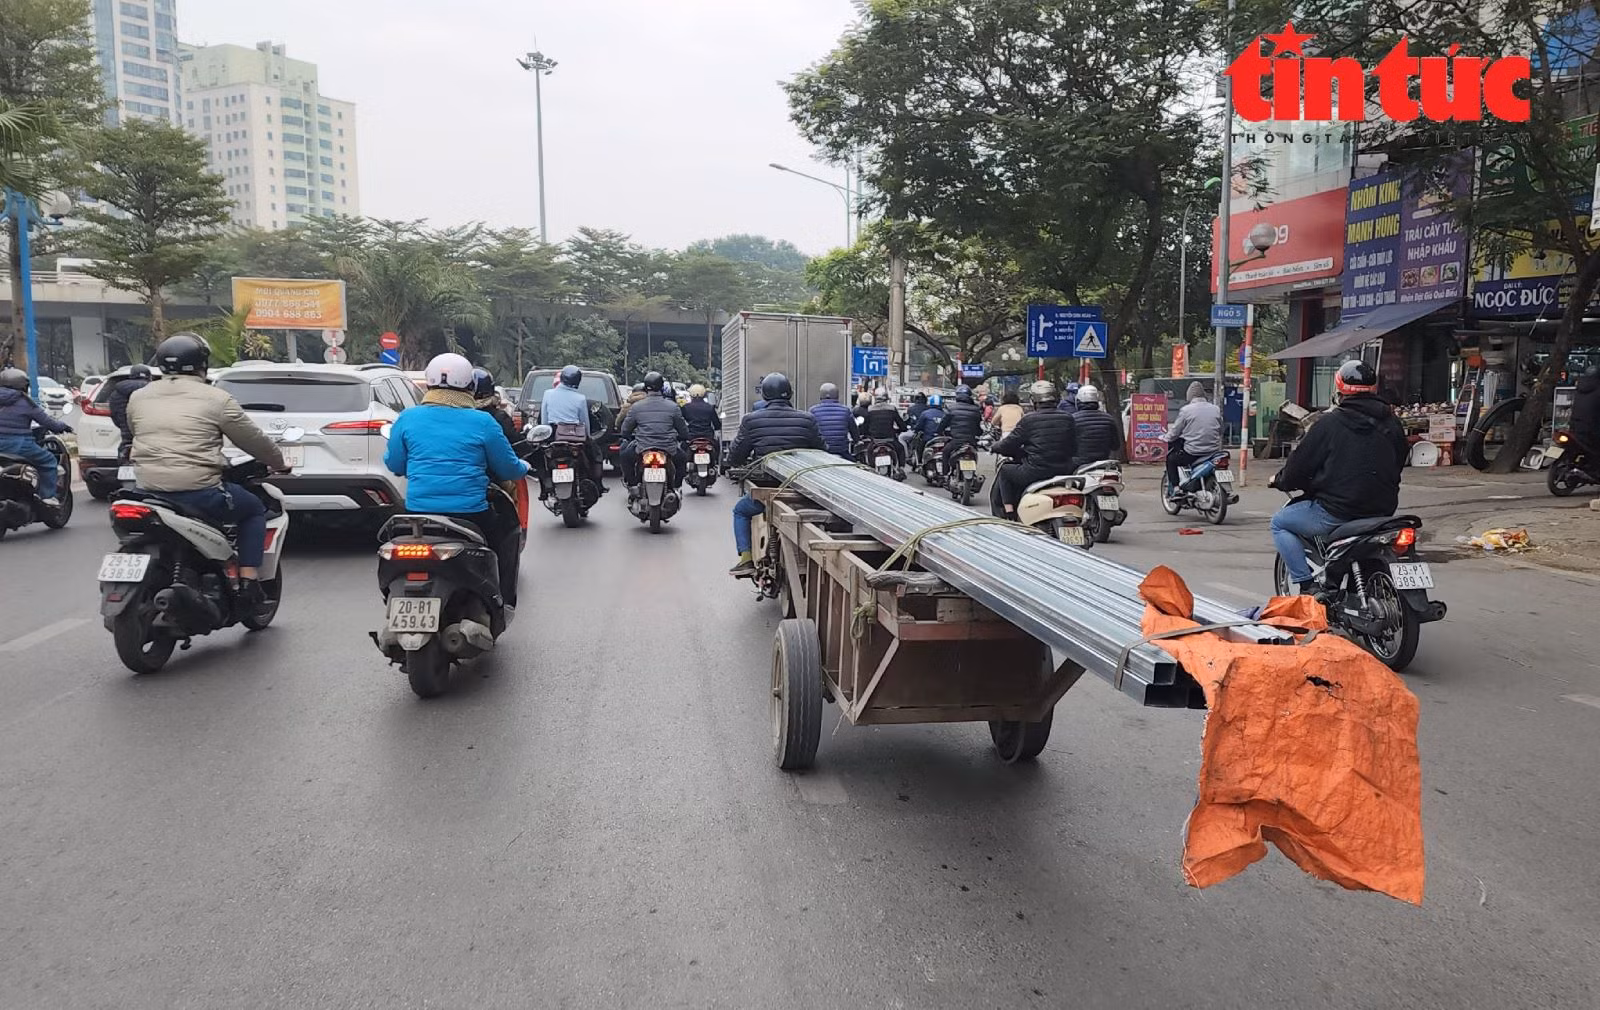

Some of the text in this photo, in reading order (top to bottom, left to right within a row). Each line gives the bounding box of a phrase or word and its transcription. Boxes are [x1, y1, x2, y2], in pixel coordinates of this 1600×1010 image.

[1351, 183, 1377, 212] NHÔM
[1347, 219, 1374, 247] MẠNH
[1405, 225, 1422, 243] TRÁI
[1424, 222, 1441, 239] CÂY
[1407, 237, 1457, 262] NHẬP KHẨU
[1475, 290, 1518, 312] NGỌC
[1520, 283, 1554, 306] ĐỨC
[1218, 307, 1235, 317] NGÕ
[398, 601, 432, 614] 20-B1
[392, 615, 436, 629] 459.43
